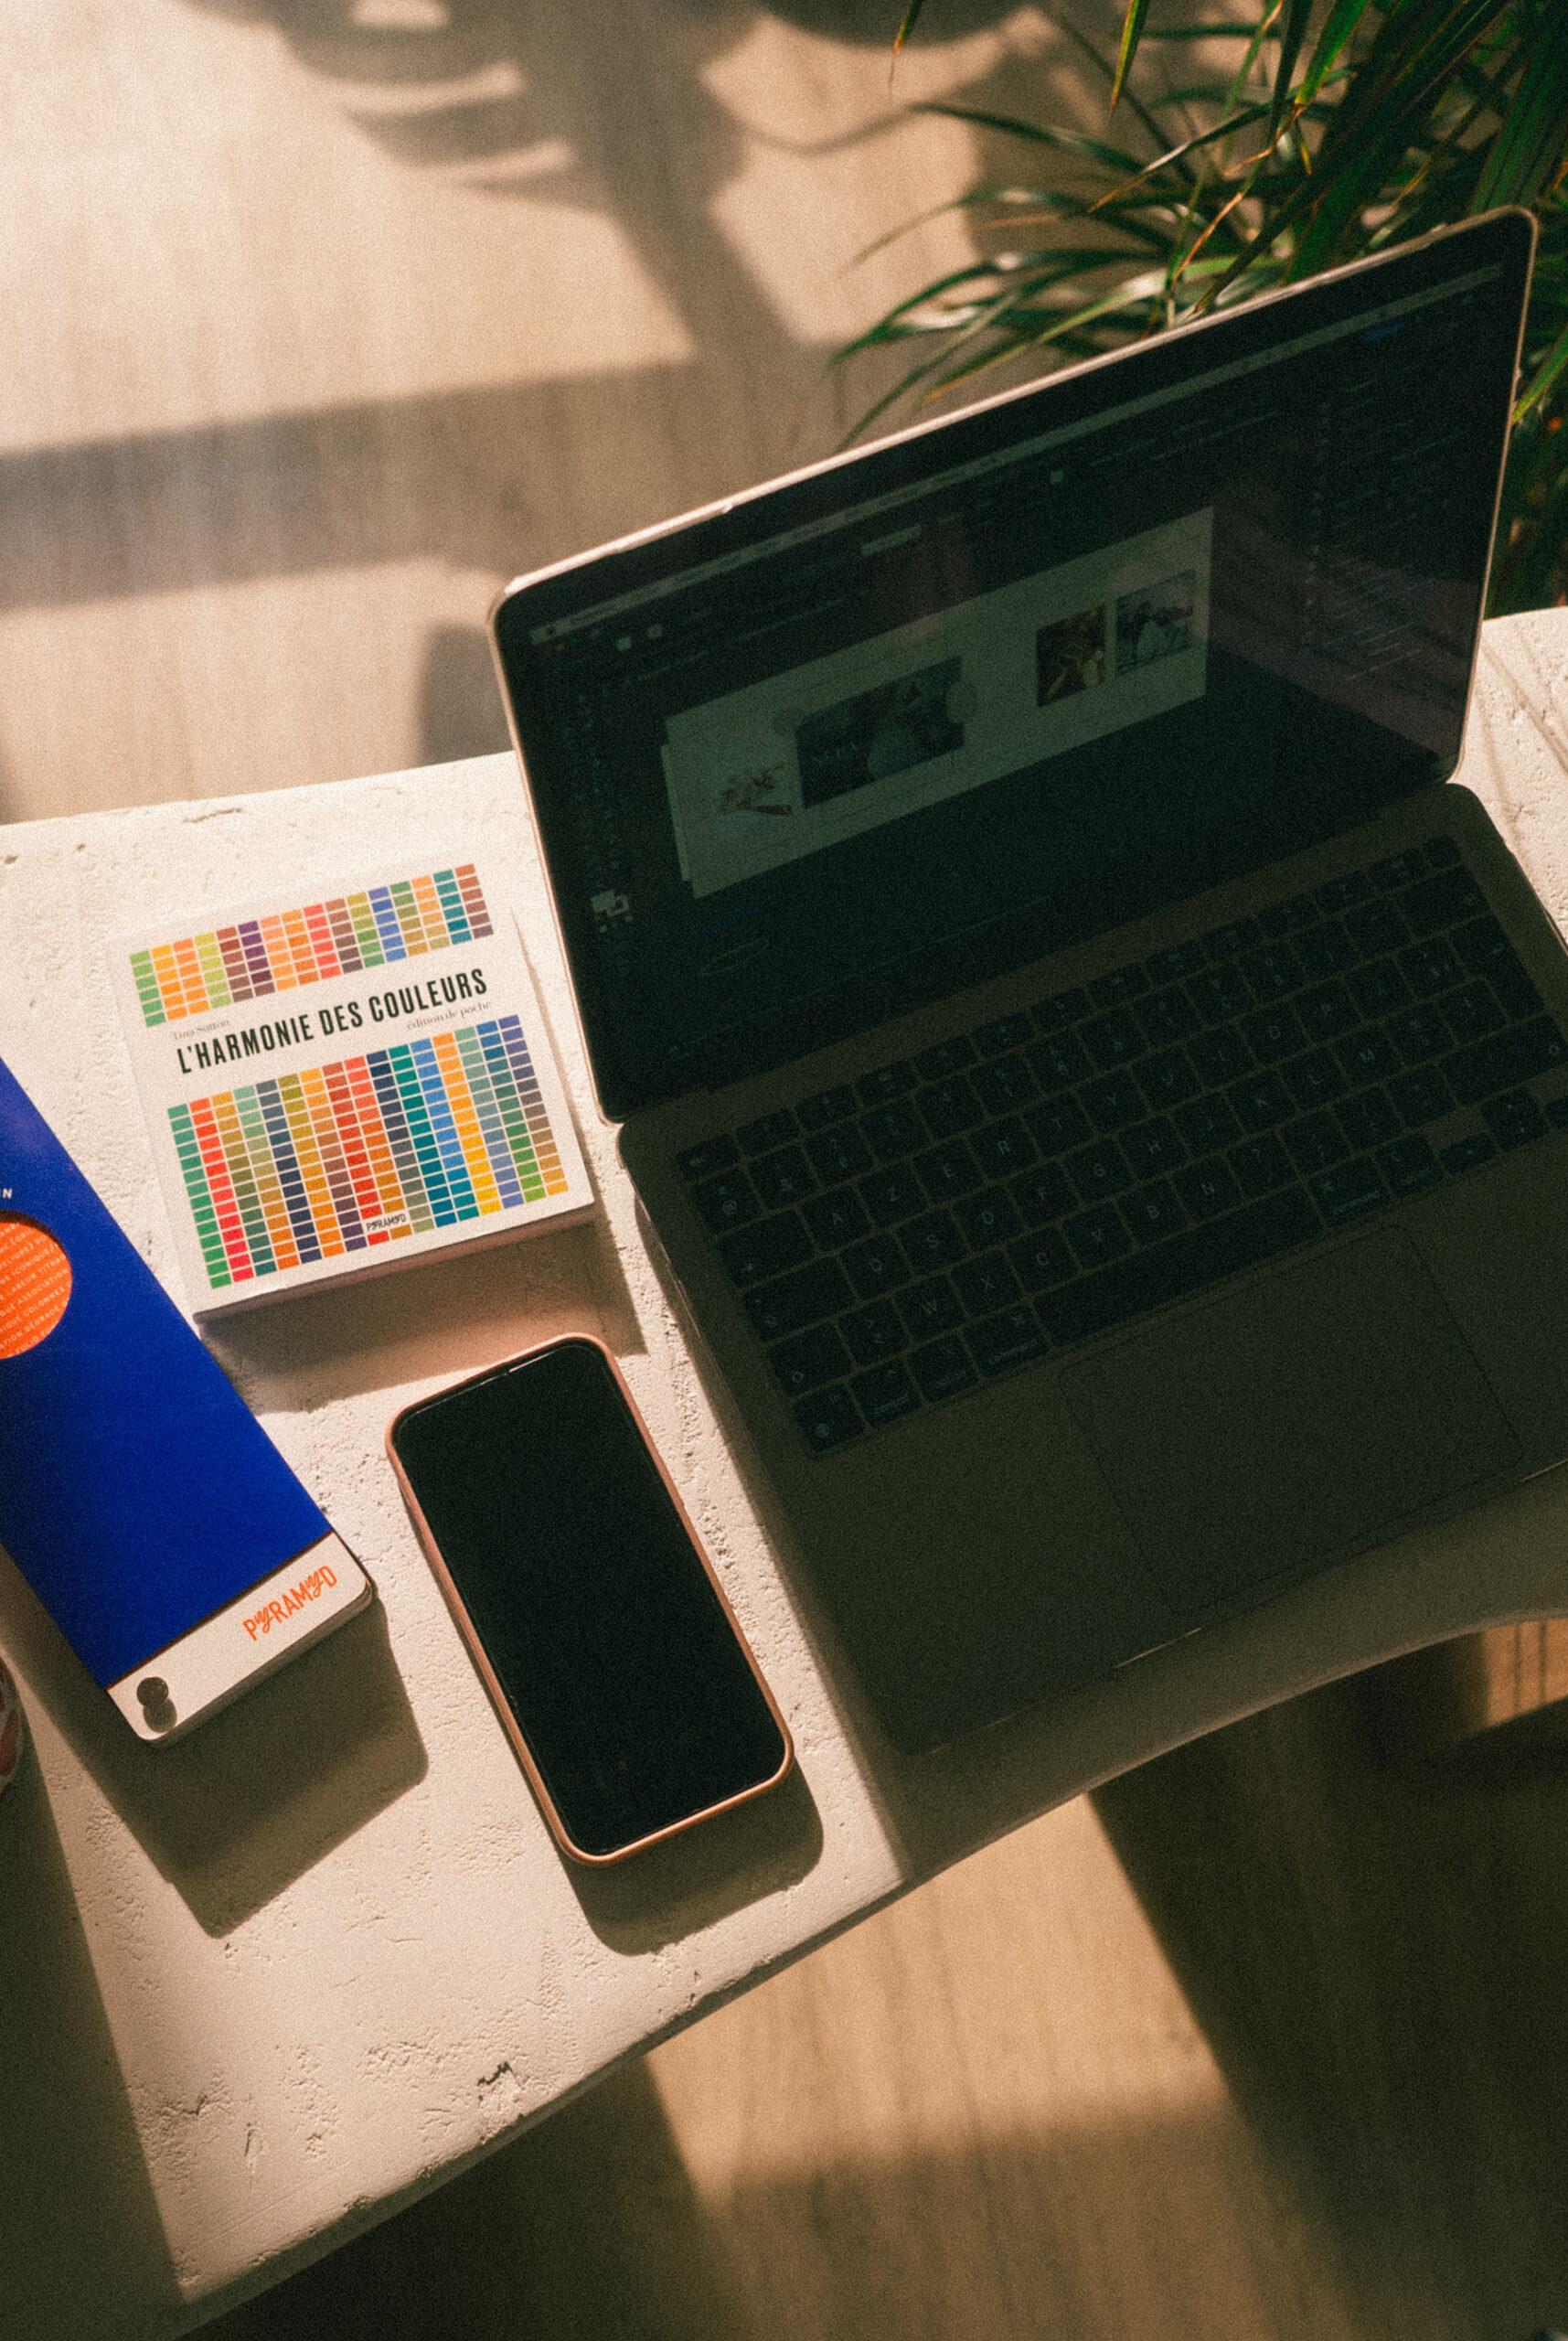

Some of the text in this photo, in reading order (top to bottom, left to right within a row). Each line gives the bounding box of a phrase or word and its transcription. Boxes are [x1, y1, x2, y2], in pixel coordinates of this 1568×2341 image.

[176, 967, 487, 1074] L'HARMONIE DES COULEURS
[366, 1213, 407, 1232] PYRAMYD
[242, 1565, 338, 1641] PYRAMYD
